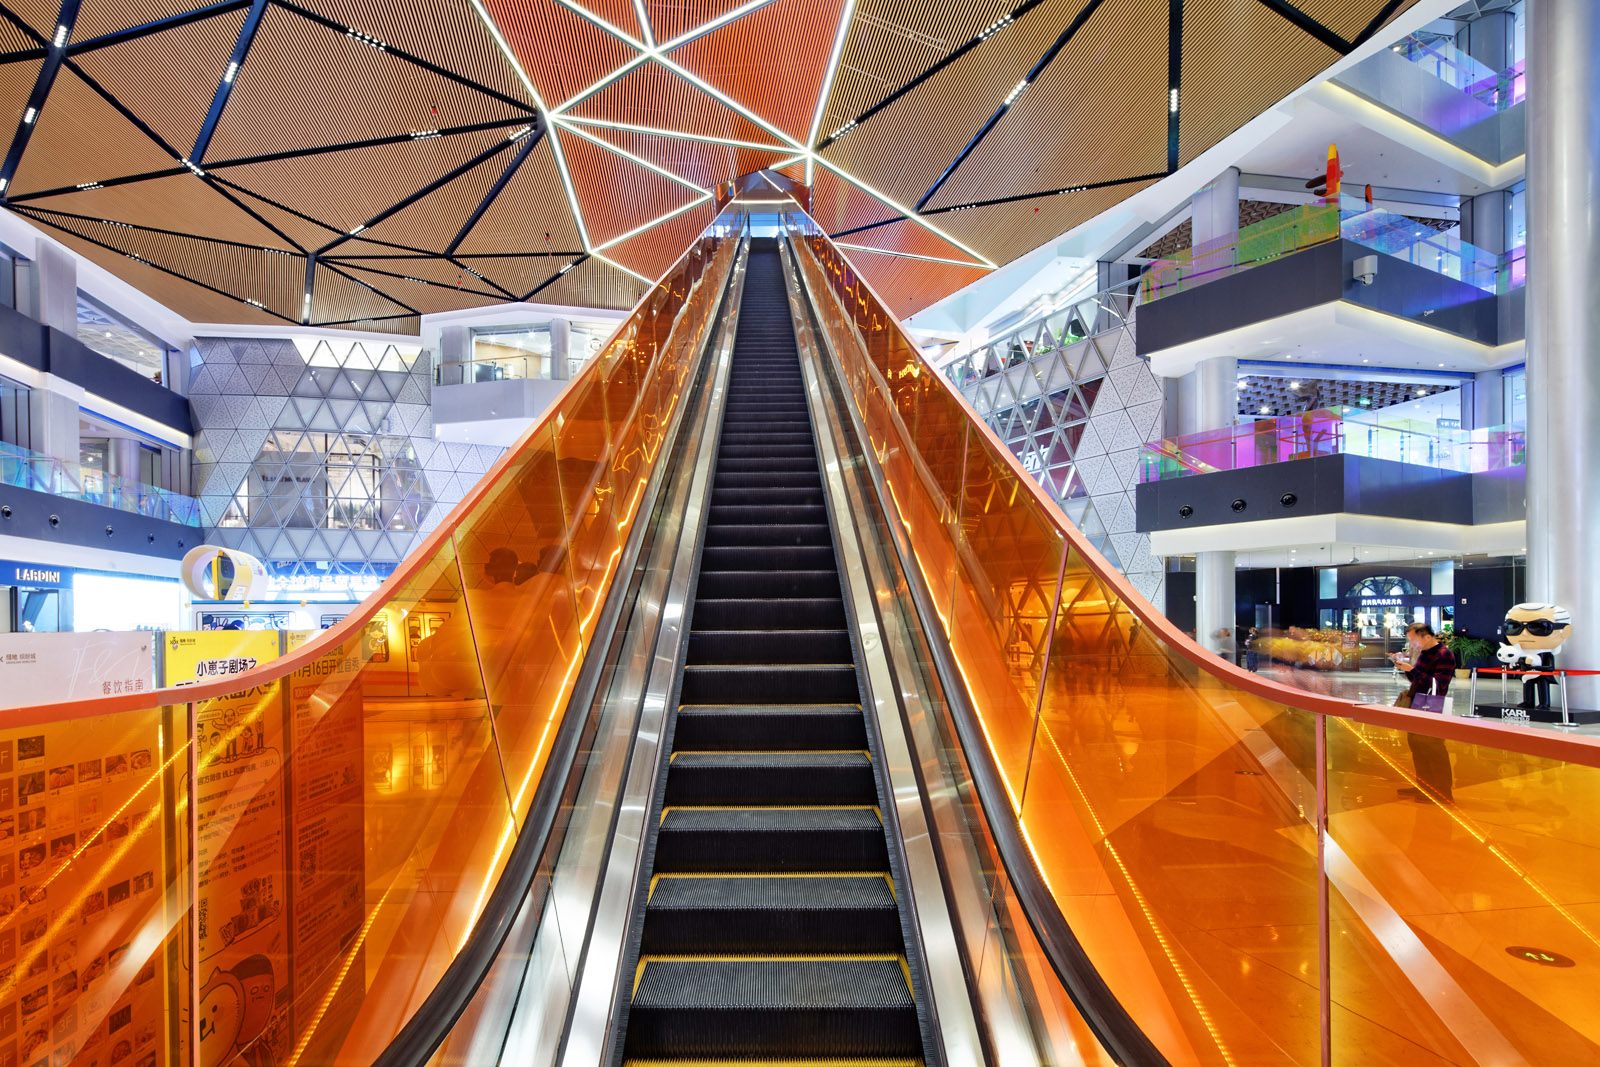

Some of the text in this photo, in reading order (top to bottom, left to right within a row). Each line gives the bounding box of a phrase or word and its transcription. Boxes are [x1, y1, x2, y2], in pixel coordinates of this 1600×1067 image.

[16, 568, 60, 583] LARDINI
[196, 657, 257, 677] 小崽子剧场之
[102, 679, 144, 695] 餐饮指南
[1501, 708, 1530, 718] KARL
[57, 1014, 73, 1033] 3F
